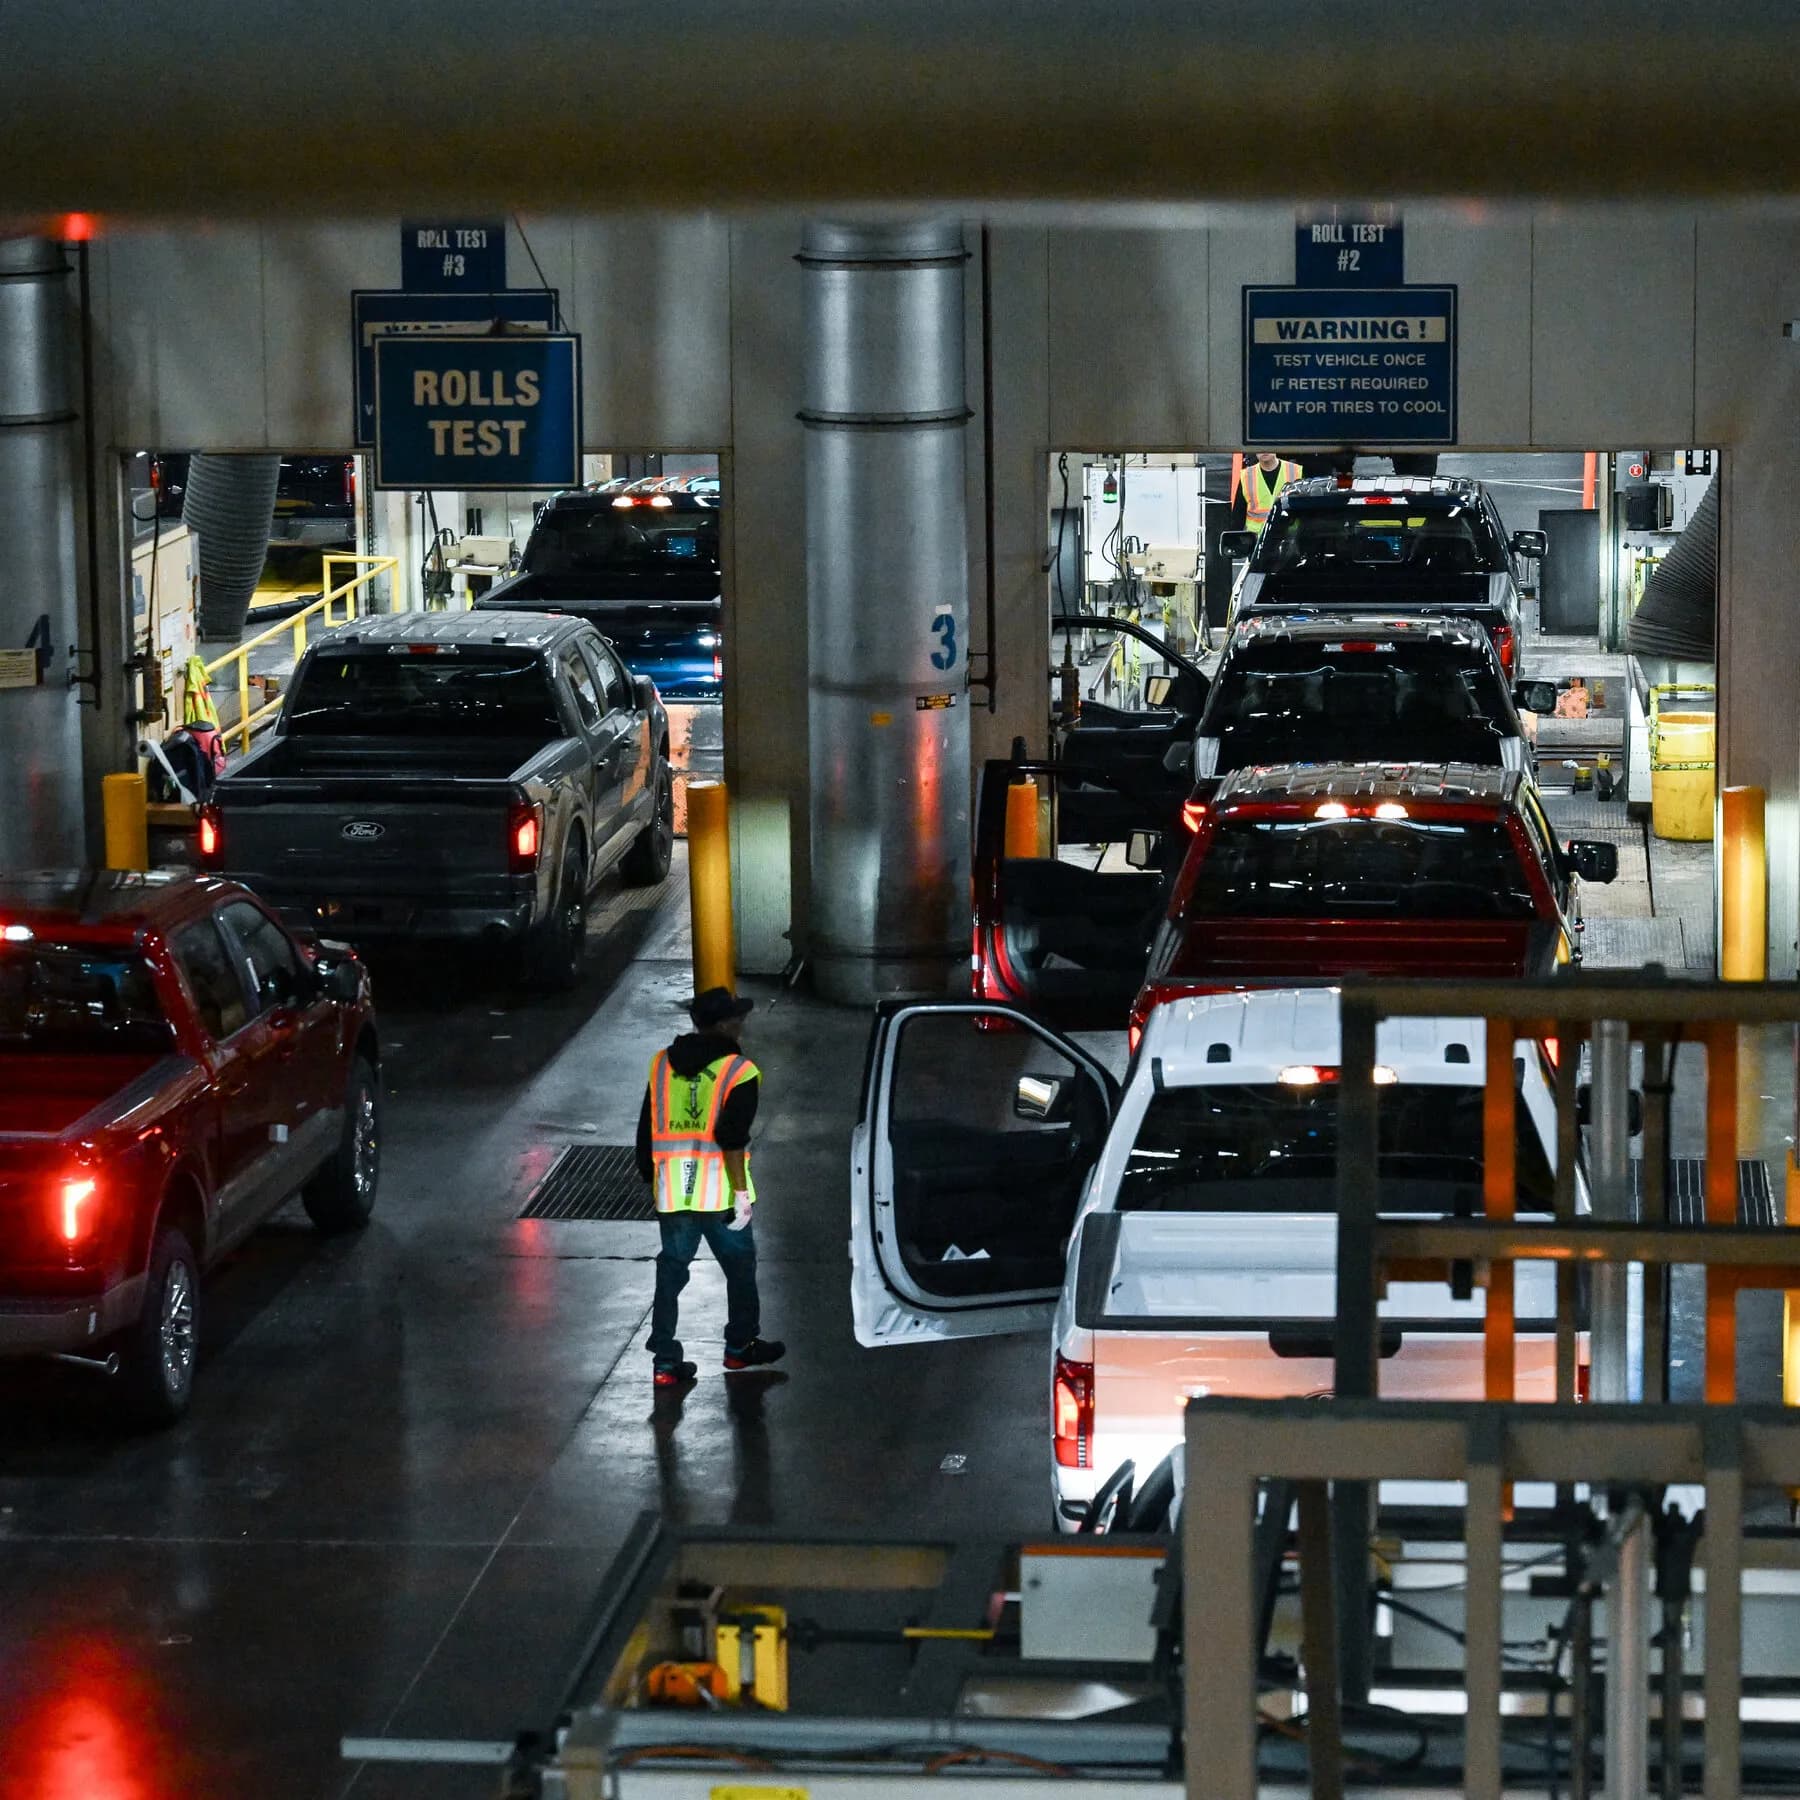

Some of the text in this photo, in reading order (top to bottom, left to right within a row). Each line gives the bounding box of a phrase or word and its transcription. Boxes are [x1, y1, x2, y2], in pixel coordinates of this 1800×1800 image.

[455, 229, 487, 248] TEST
[1311, 223, 1385, 243] ROLL TEST
[442, 253, 466, 277] #3
[1337, 248, 1361, 272] #2
[1276, 320, 1427, 340] WARNING !
[1273, 353, 1426, 367] TEST VEHICLE ONCE
[413, 369, 541, 407] ROLLS
[1271, 377, 1429, 390] IF RETEST REQUIRED
[1254, 400, 1446, 414] WAIT FOR TIRES TO COOL
[428, 419, 527, 457] TEST
[930, 613, 957, 671] 3
